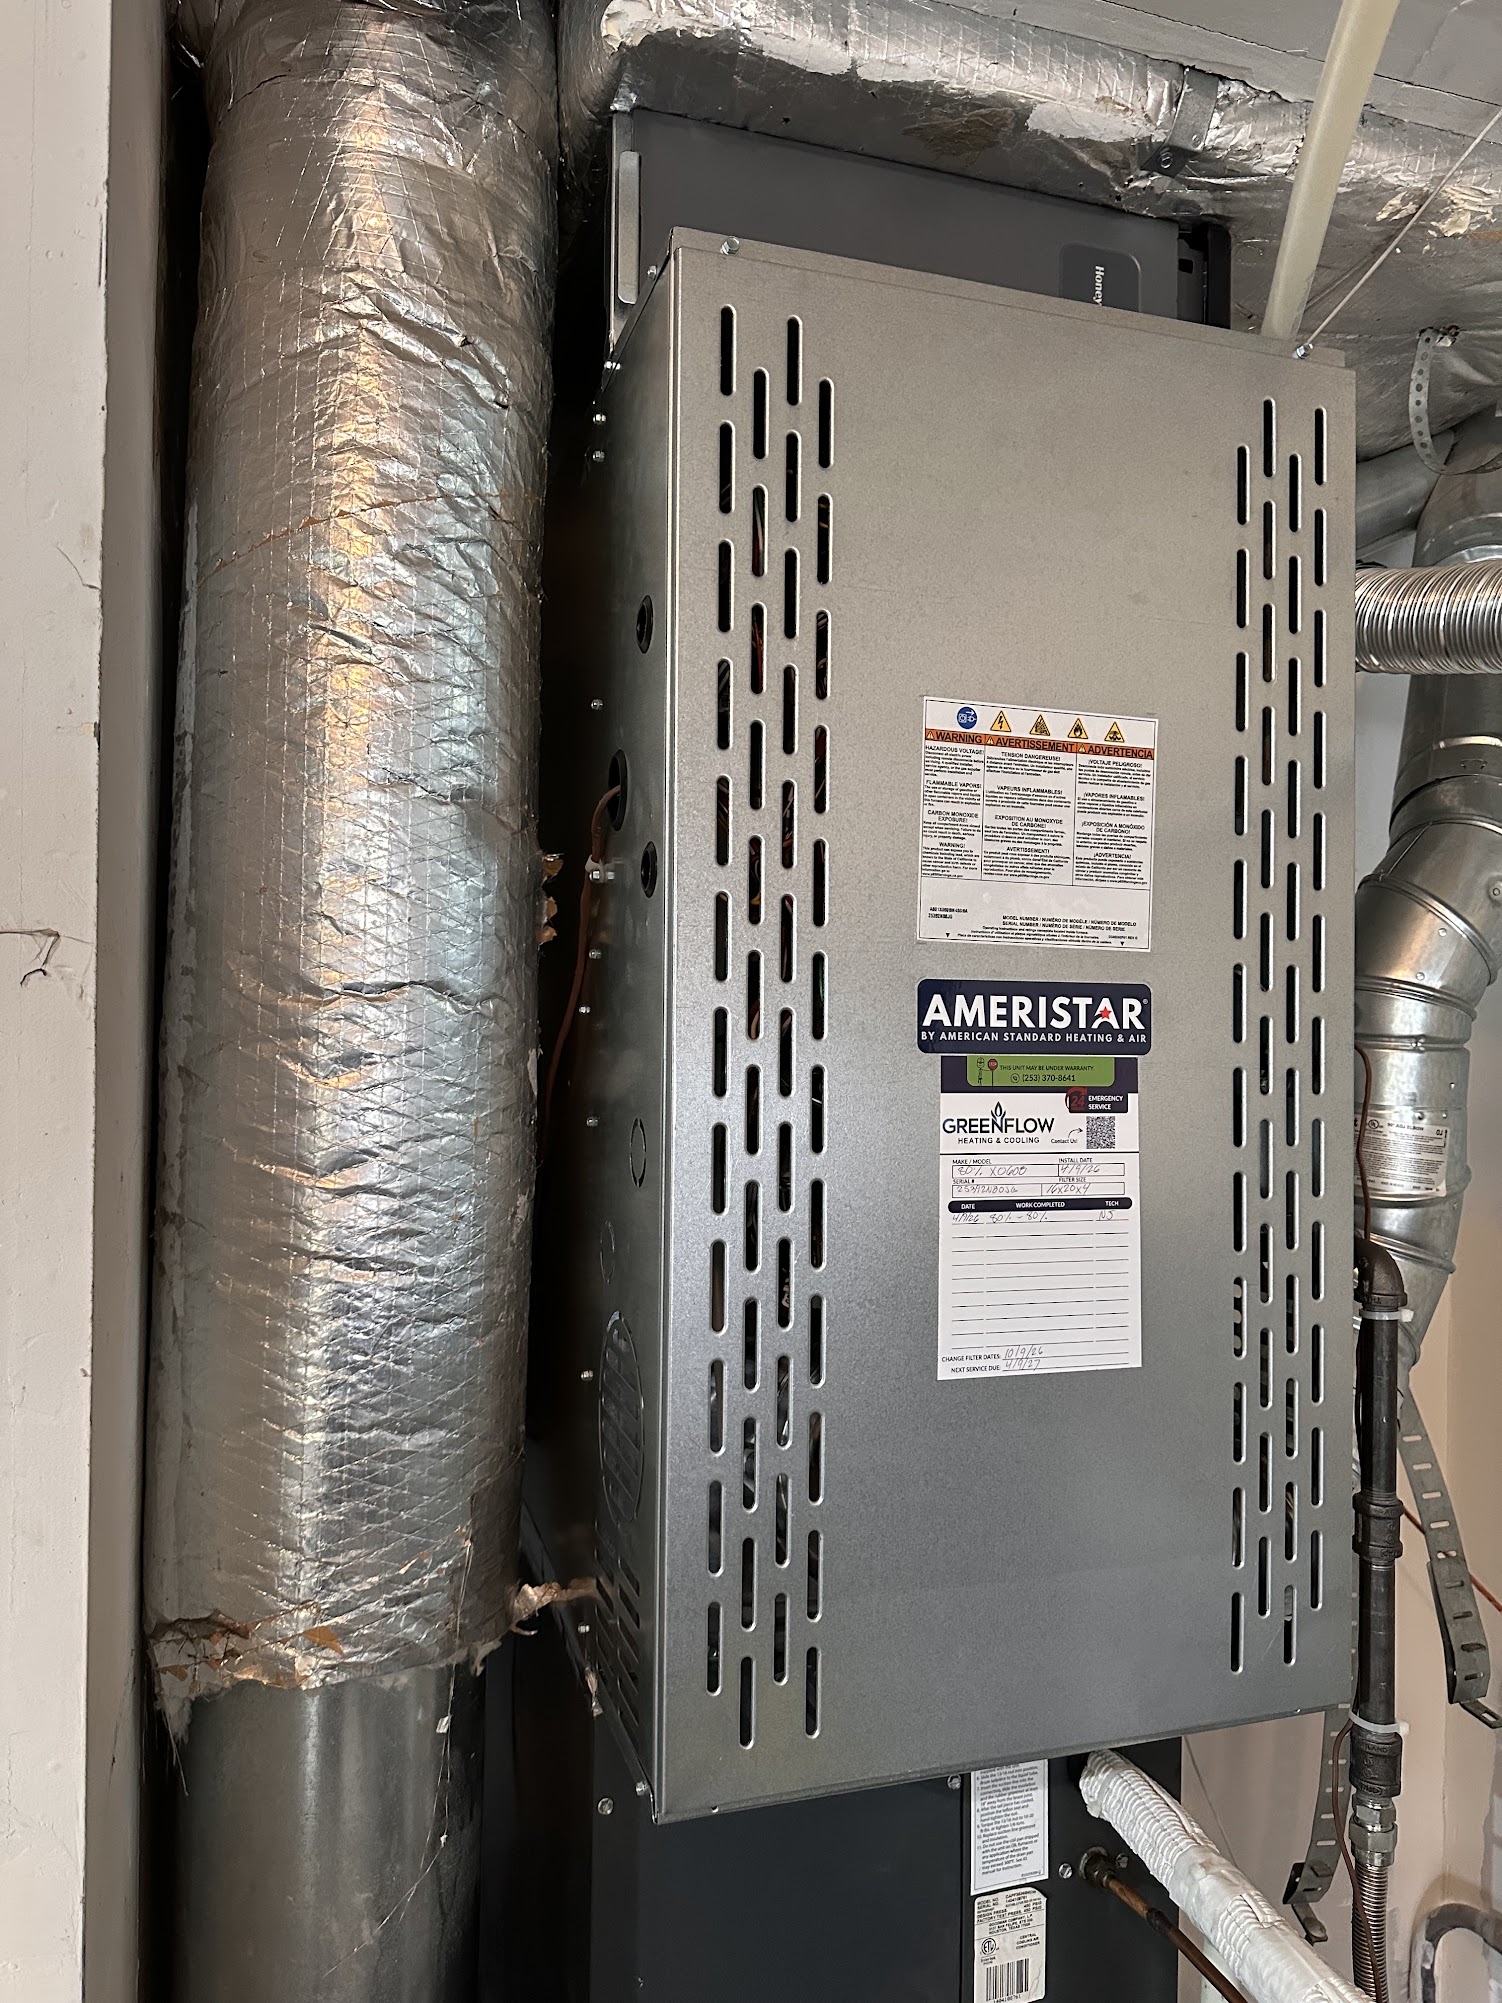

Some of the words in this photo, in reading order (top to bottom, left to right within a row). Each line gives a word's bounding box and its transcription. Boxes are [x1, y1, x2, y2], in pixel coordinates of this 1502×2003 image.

[936, 732, 982, 743] WARNING
[996, 738, 1074, 751] AVERTISSEMENT
[1088, 746, 1152, 758] ADVERTENCIA
[1022, 787, 1062, 795] INFLAMMABLES!
[921, 1031, 935, 1040] BY
[940, 1032, 998, 1041] AMERICAN
[1003, 1032, 1062, 1042] STANDARD
[1066, 1033, 1112, 1042] HEATING
[1117, 1034, 1124, 1042] &
[1128, 1034, 1146, 1043] AIR
[1022, 1073, 1040, 1082] (253)
[1071, 1096, 1085, 1106] 24
[942, 1116, 1054, 1134] GREENFLOW
[1061, 1164, 1100, 1174] 4/9/26
[1005, 1345, 1043, 1359] 10/9/26
[1006, 1359, 1040, 1371] 4/9/27
